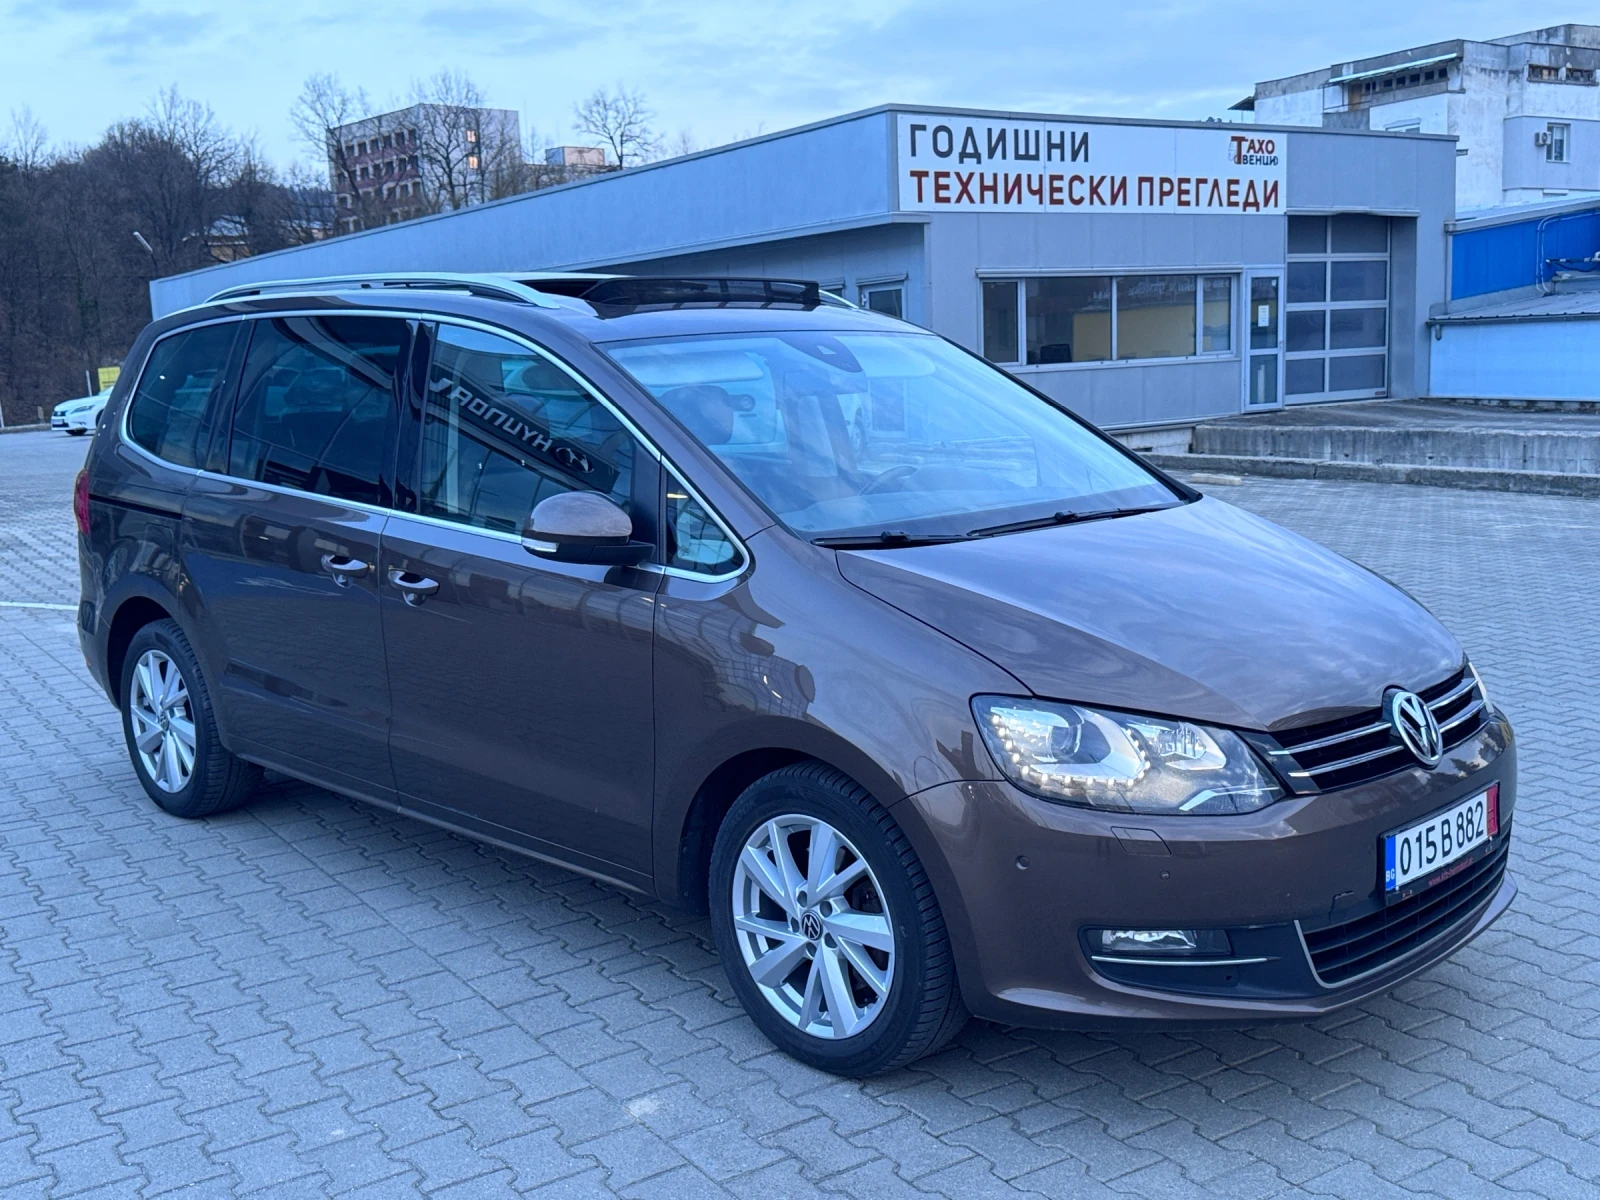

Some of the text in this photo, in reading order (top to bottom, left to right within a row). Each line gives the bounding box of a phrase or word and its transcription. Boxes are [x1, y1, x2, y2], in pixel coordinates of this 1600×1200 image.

[909, 123, 1090, 165] ГОДИШНИ
[909, 170, 1279, 213] ТЕХНИЧЕСКИ ПРЕГЛЕДИ
[1385, 867, 1396, 883] BG
